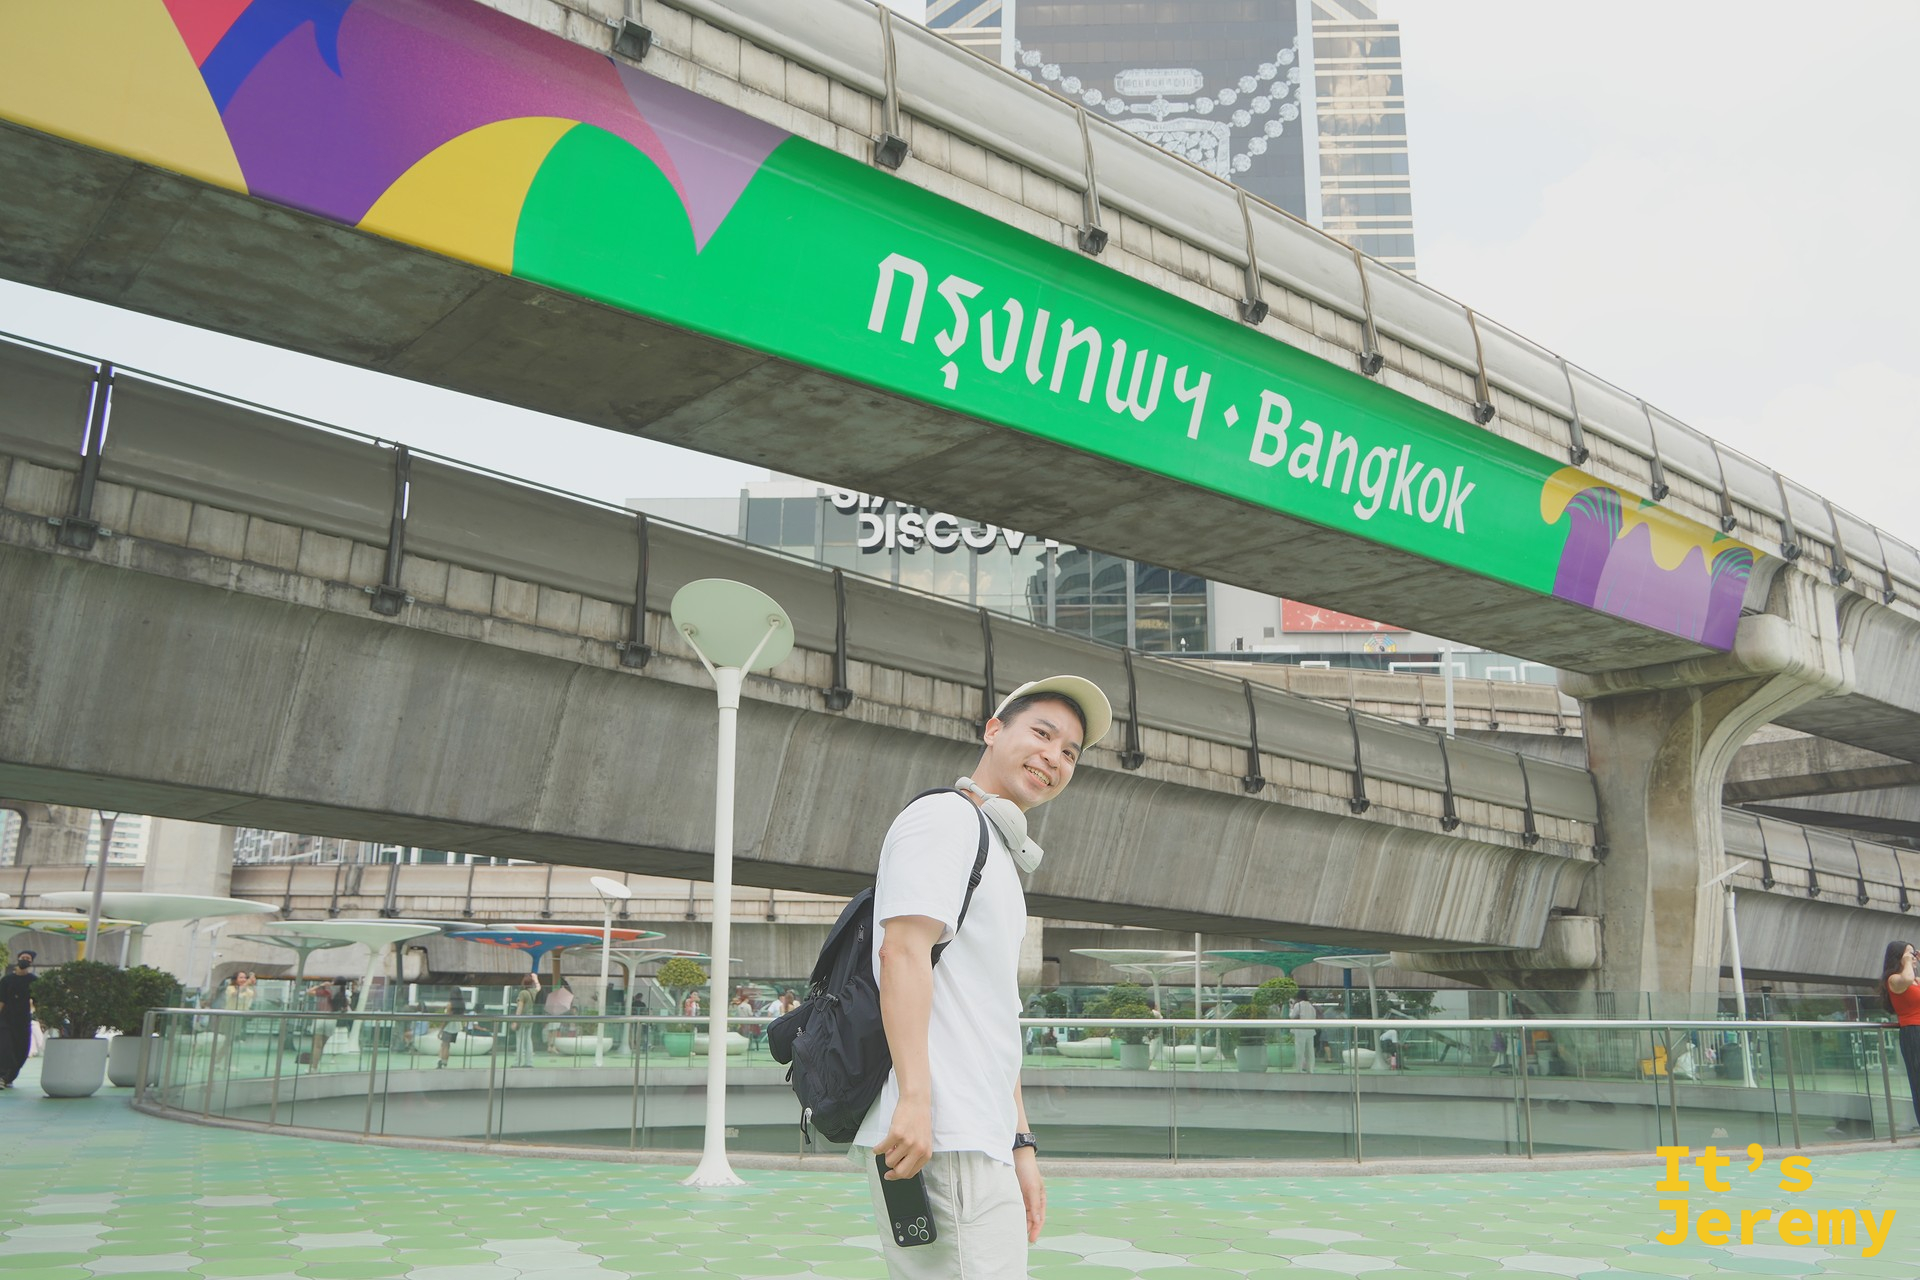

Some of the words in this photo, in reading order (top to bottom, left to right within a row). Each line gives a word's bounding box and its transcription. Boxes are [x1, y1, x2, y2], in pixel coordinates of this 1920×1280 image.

[867, 252, 1212, 440] กรุงเทพฯ
[1248, 388, 1476, 535] Bangkok
